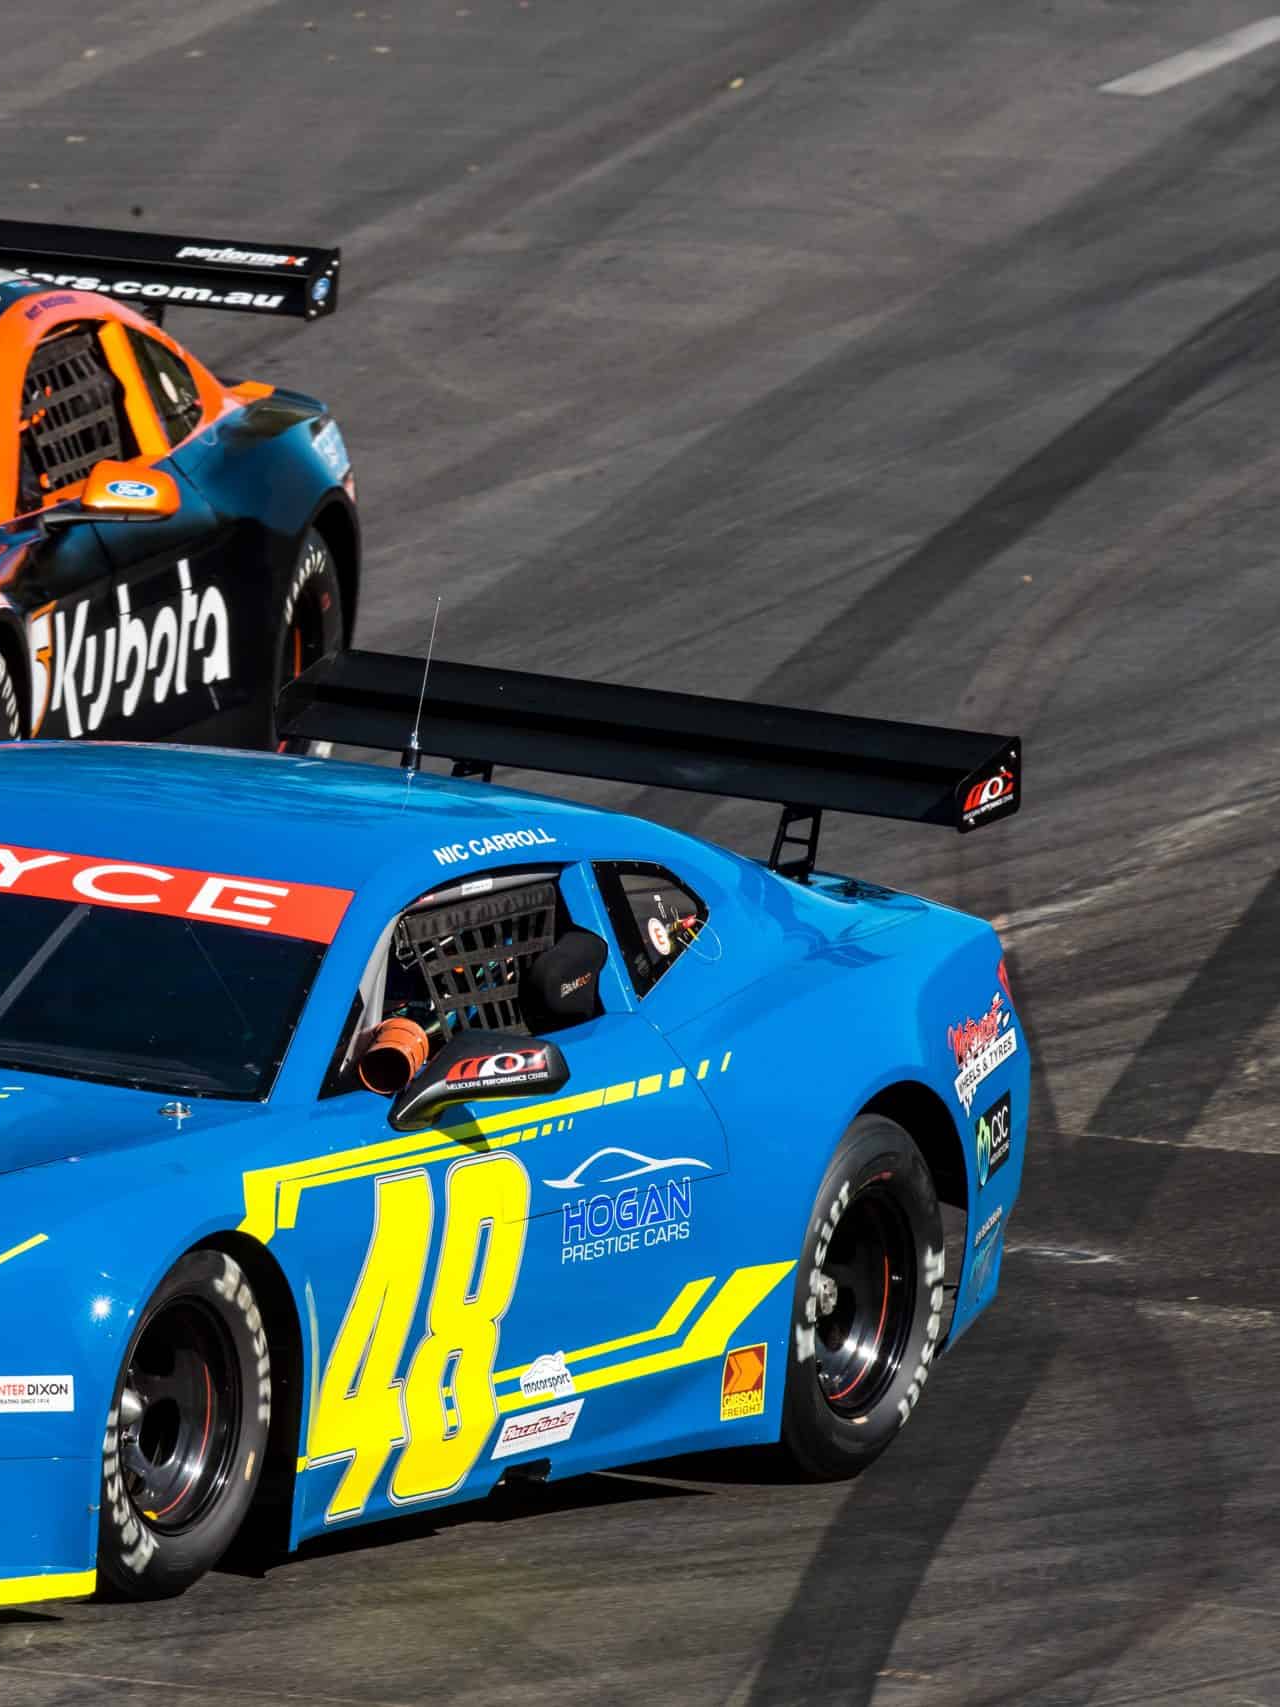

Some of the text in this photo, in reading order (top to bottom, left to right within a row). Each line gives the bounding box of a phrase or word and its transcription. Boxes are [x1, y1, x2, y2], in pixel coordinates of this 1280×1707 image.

[175, 245, 310, 267] performax
[51, 558, 231, 739] Kubota
[432, 828, 557, 865] NIC CARROLL
[989, 1035, 1013, 1065] TYRES
[991, 1104, 1009, 1148] CSC
[562, 1176, 692, 1245] HOGAN
[561, 1221, 690, 1265] PRESTIGE CARS
[305, 1150, 532, 1526] 48
[26, 1383, 69, 1396] DIXON
[523, 1372, 571, 1396] motorsport
[723, 1388, 763, 1408] GIBSON
[722, 1403, 761, 1418] FREIGHT
